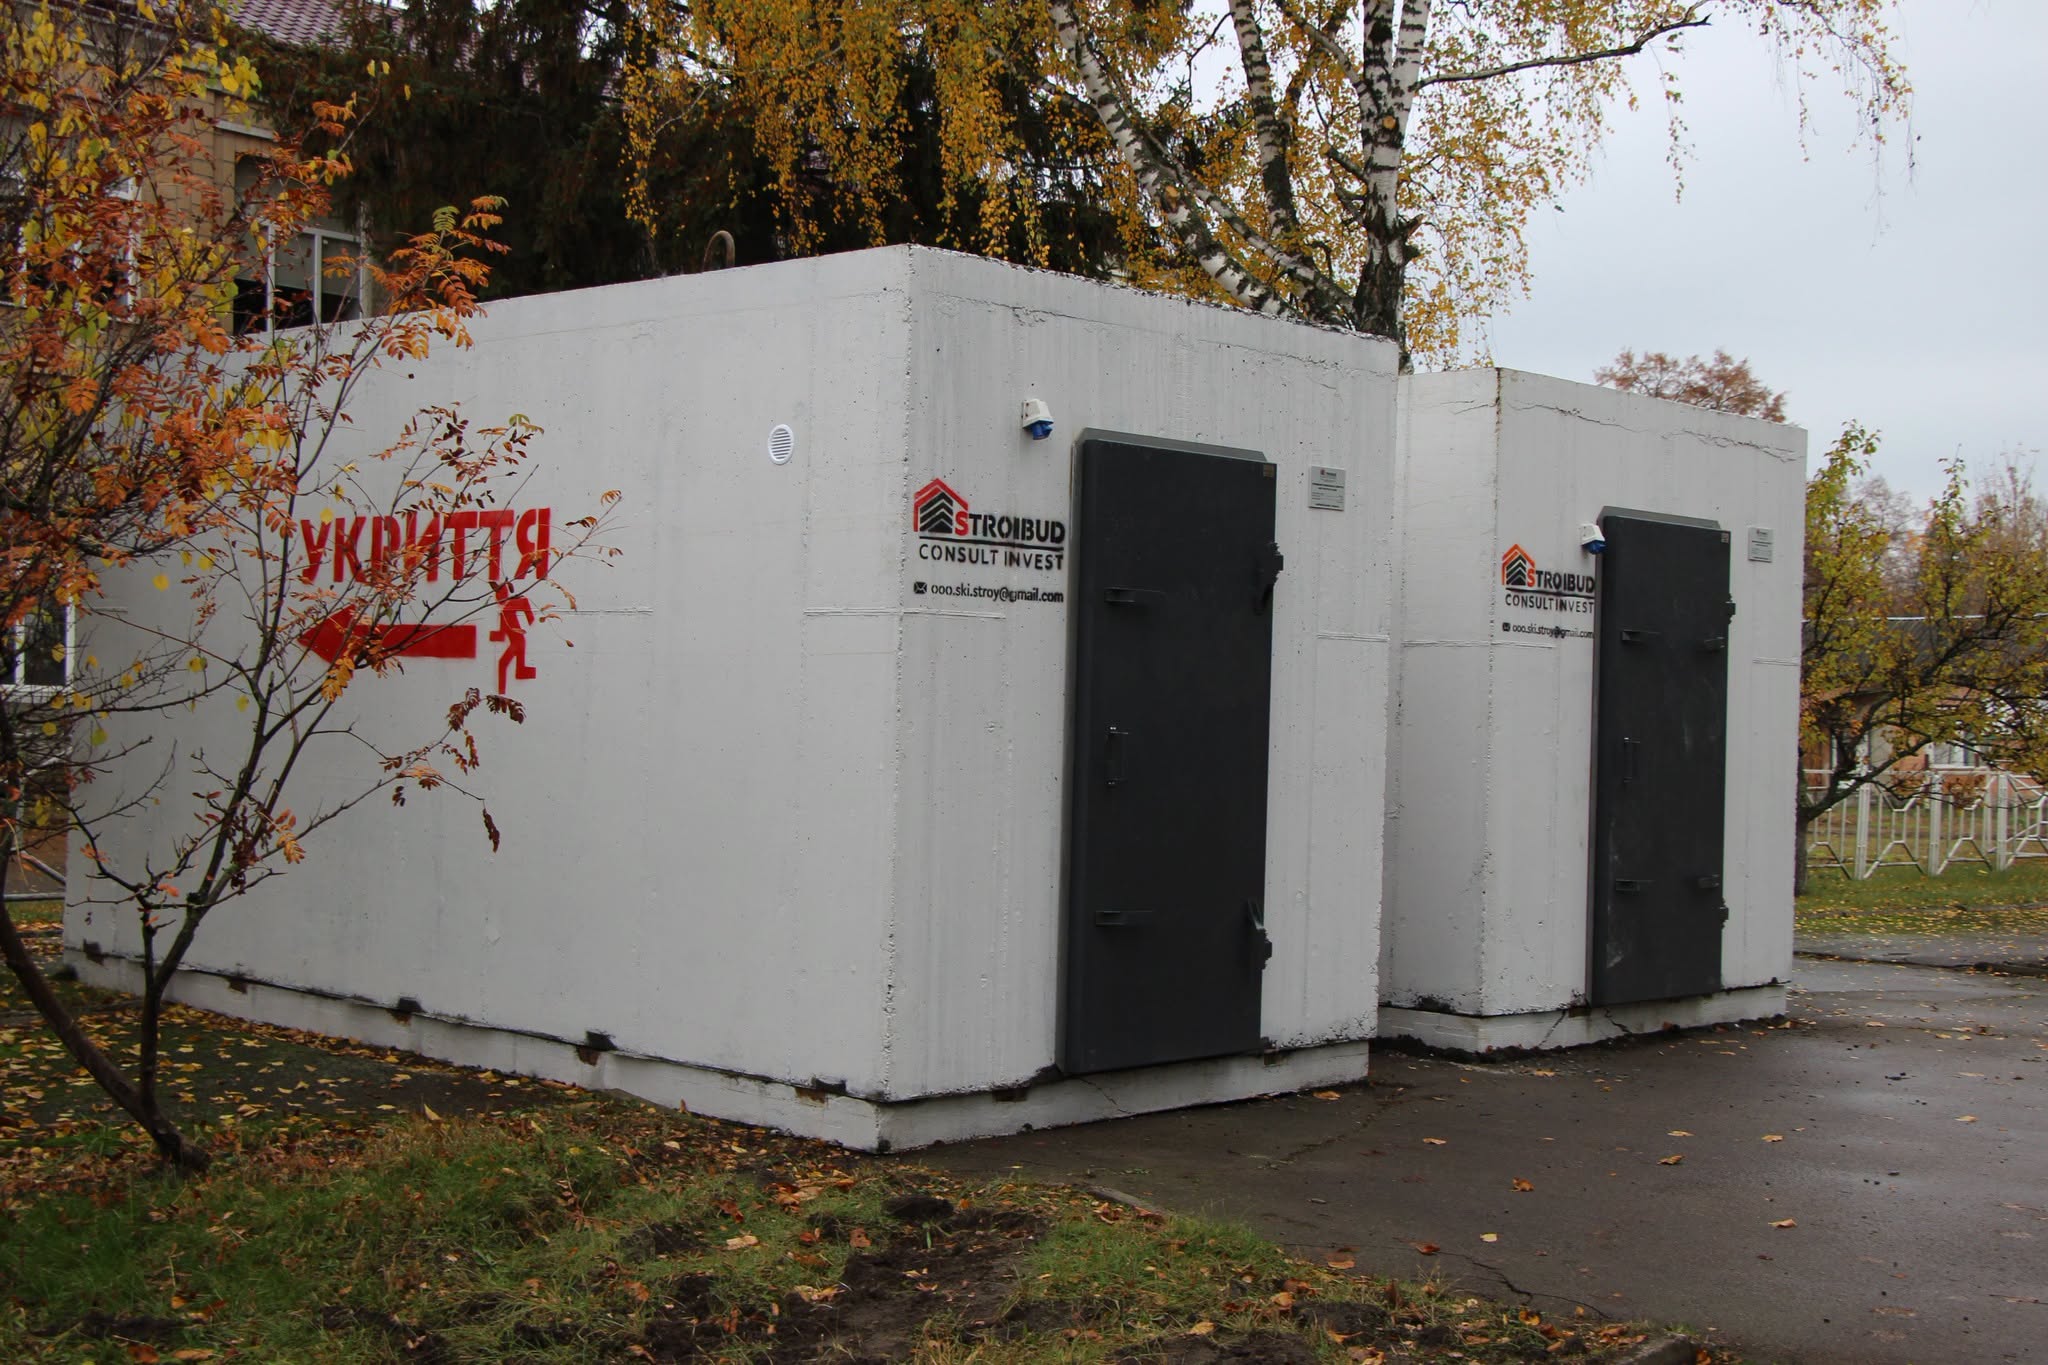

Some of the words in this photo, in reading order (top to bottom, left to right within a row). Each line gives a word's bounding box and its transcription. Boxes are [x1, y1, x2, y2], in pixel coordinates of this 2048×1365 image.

[954, 510, 1065, 544] STROIBUD
[300, 507, 551, 585] УКРИТТЯ
[919, 543, 999, 565] CONSULT
[1004, 551, 1064, 570] INVEST
[931, 583, 1064, 603] ooo.ski.stroy@gmail.com
[1526, 568, 1595, 593] STROIBUD
[1505, 594, 1554, 610] CONSULT
[1555, 598, 1595, 614] INVEST
